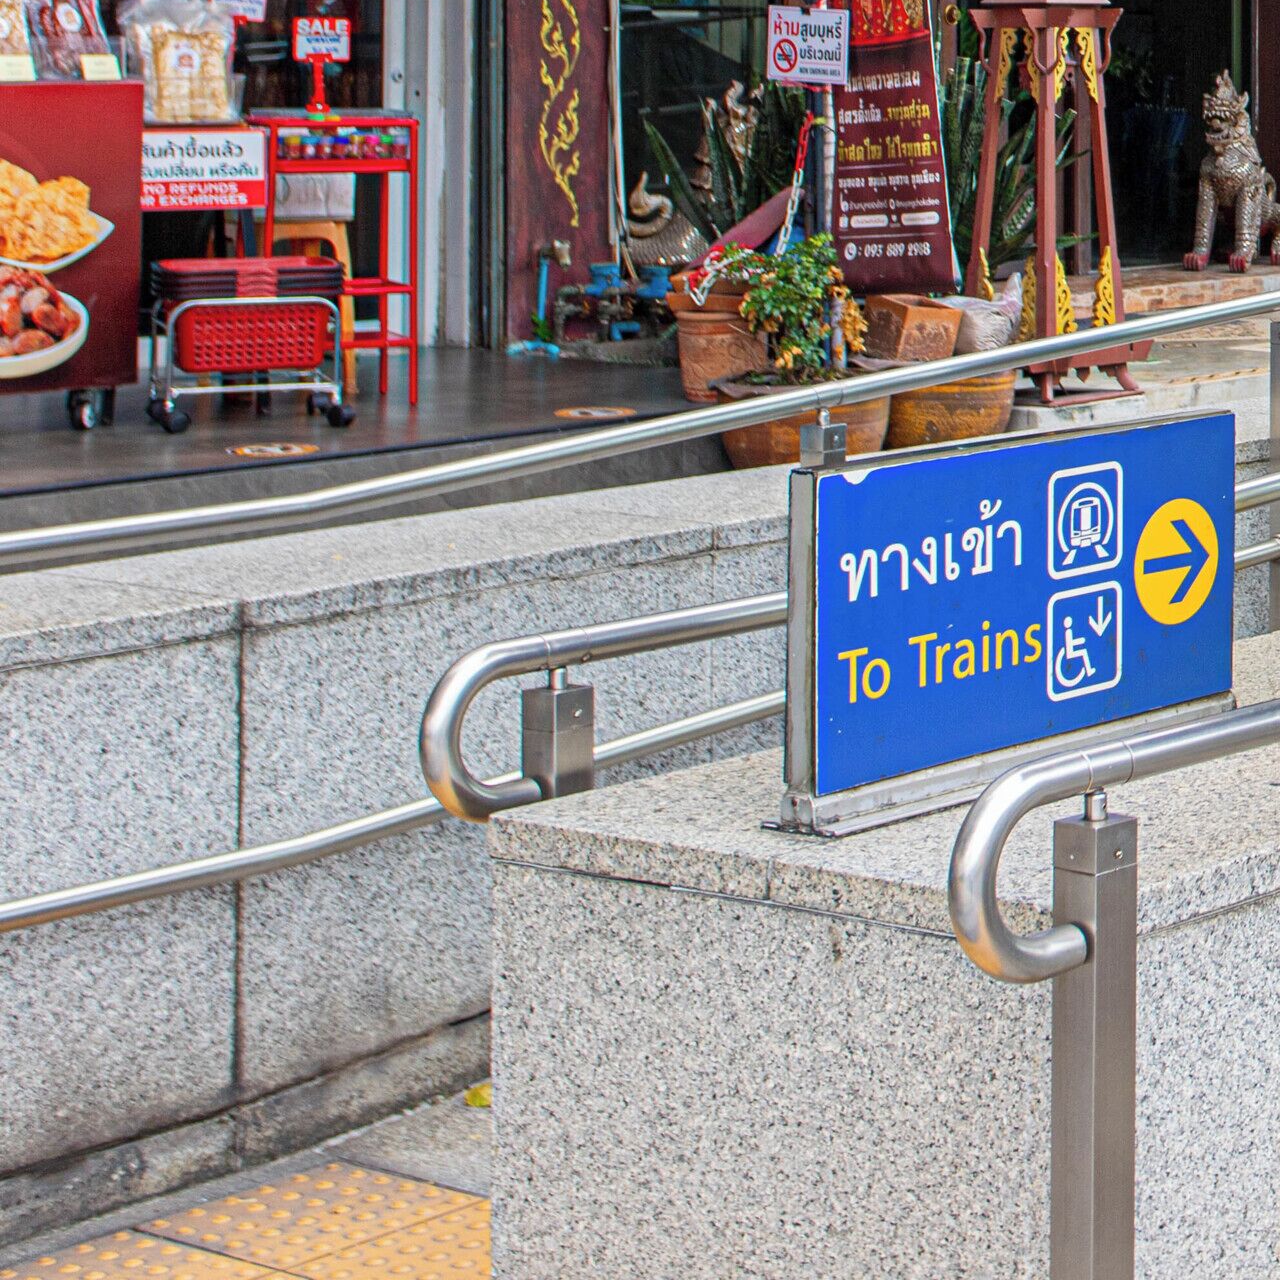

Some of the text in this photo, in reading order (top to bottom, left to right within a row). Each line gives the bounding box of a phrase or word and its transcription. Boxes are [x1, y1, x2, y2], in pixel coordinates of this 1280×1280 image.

[297, 19, 348, 36] SALE
[773, 13, 842, 43] ห้ามสูบบุหรี่
[799, 43, 842, 62] บริเวณนี้
[143, 182, 238, 196] NO REFUNDS
[159, 193, 248, 206] EXCHANGES
[840, 499, 1023, 602] ทางเข้า
[838, 620, 1042, 704] To Trains
